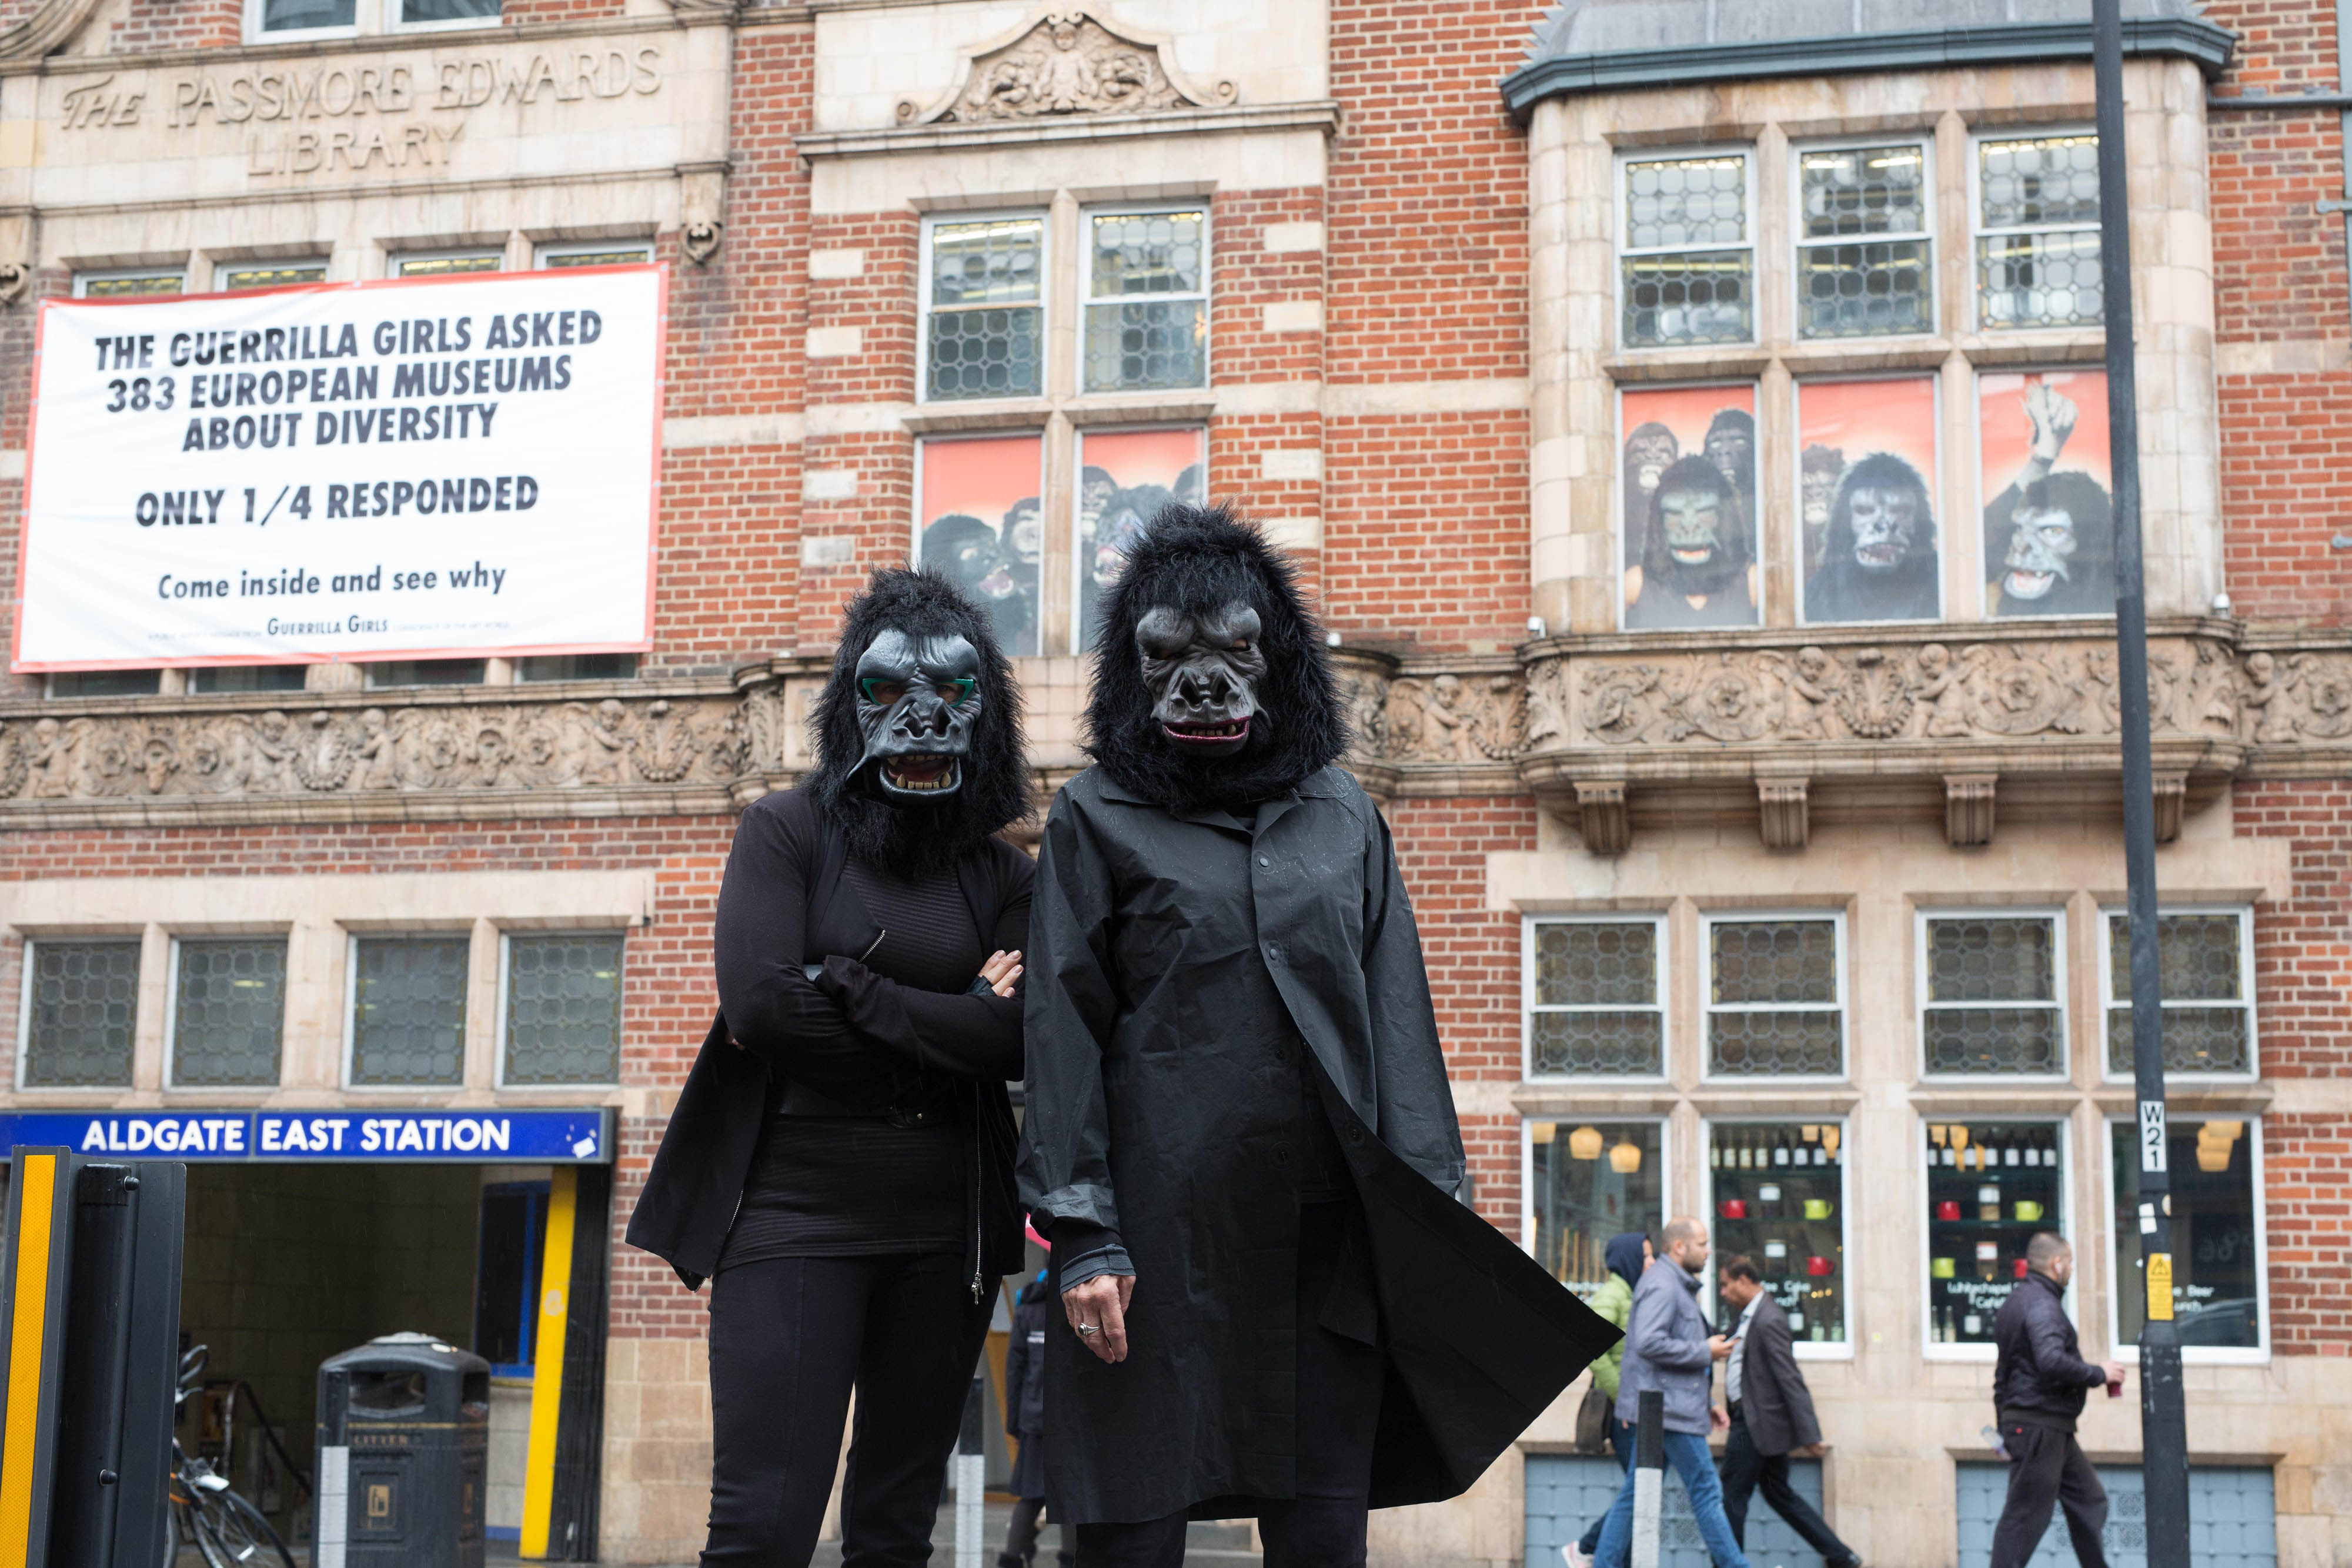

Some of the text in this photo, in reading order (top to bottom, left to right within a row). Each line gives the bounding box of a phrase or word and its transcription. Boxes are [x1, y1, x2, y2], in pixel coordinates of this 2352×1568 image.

[61, 47, 663, 130] THE PASSMORE EDWARDS
[247, 121, 465, 176] LIBRARY
[95, 310, 602, 370] THE GUERRILLA GIRLS ASKED
[106, 355, 571, 413] 383 EUROPEAN MUSEUMS
[182, 403, 498, 452] ABOUT DIVERSITY
[136, 476, 539, 527] ONLY 1/4 RESPONDED
[158, 560, 506, 599] Come inside and see why
[267, 617, 342, 637] GUERRILLA
[348, 614, 388, 634] GIRLS
[82, 1119, 510, 1151] ALDGATE EAST STATION
[2174, 1300, 2202, 1312] unch
[2187, 1283, 2215, 1298] Beer
